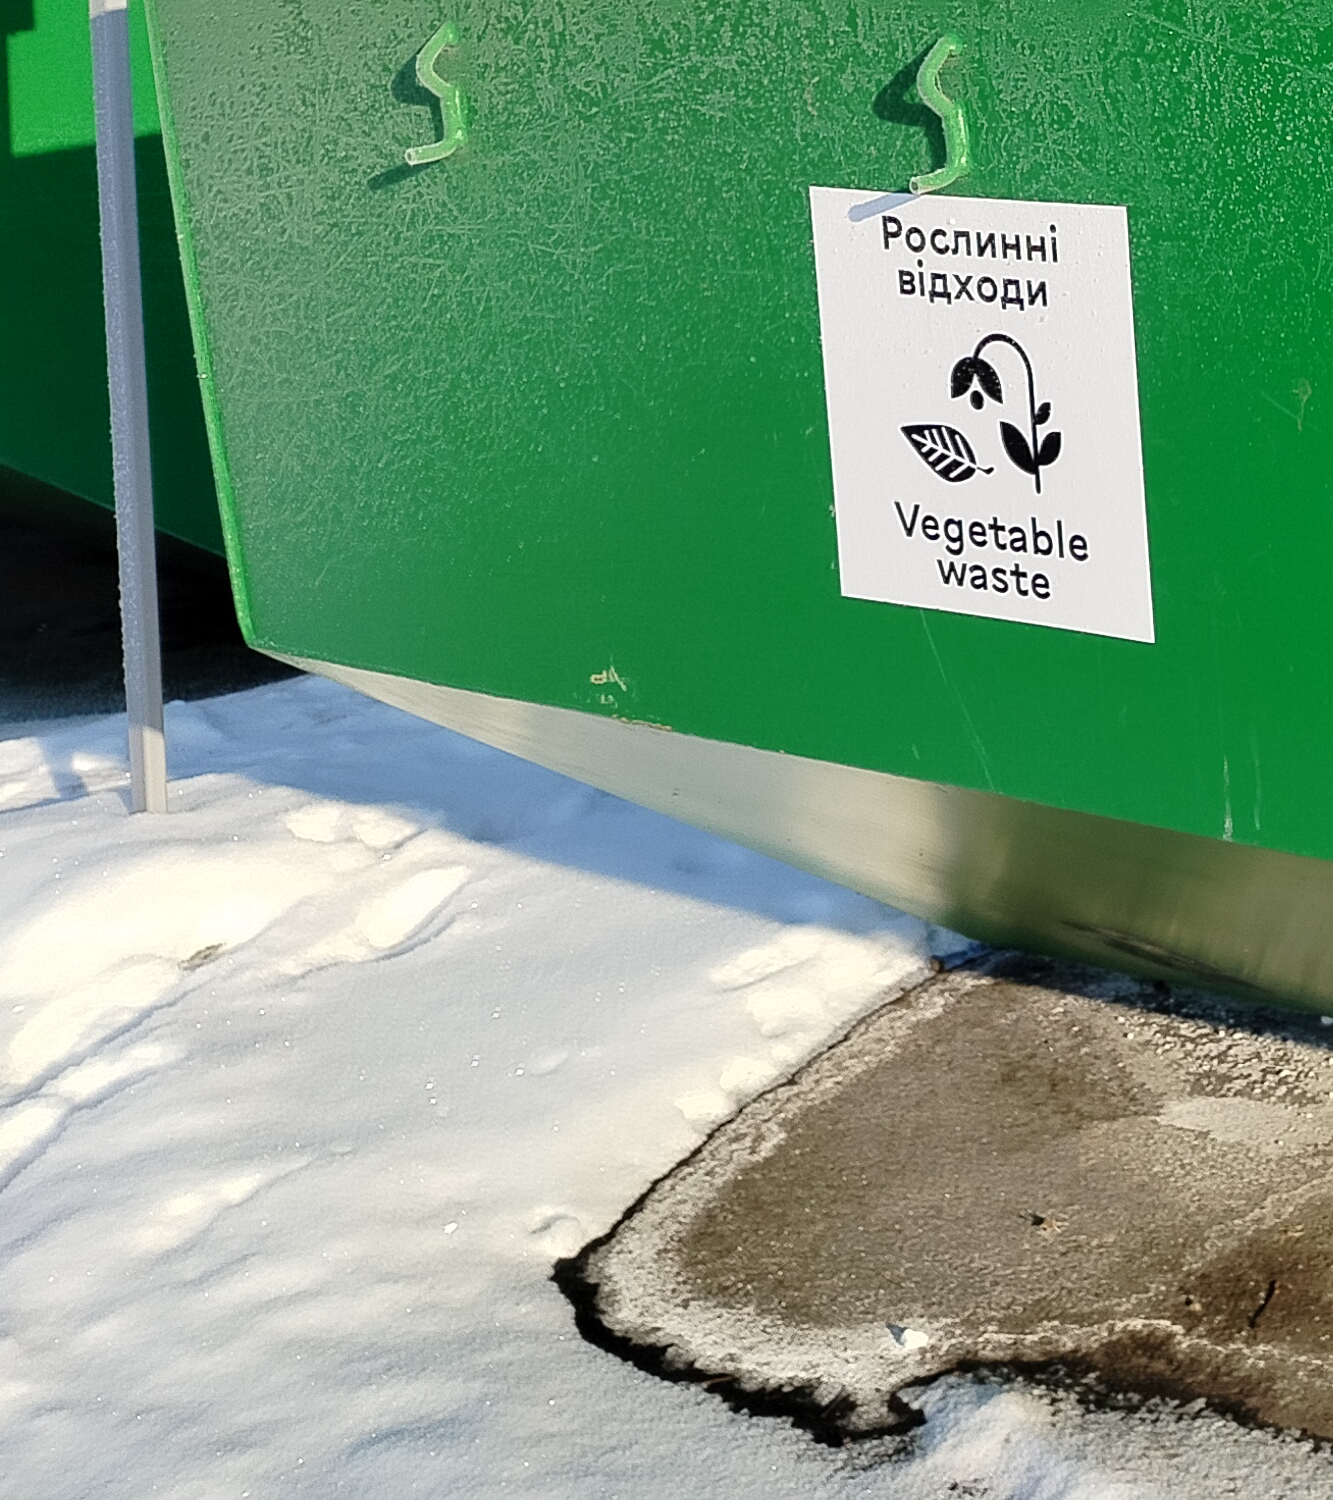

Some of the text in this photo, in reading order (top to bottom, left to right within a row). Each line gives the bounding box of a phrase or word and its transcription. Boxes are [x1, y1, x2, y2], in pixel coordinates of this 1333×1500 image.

[882, 215, 1059, 263] Рослинні
[898, 259, 1049, 311] відходи
[894, 501, 1089, 561] Vegetable
[936, 559, 1051, 599] waste
